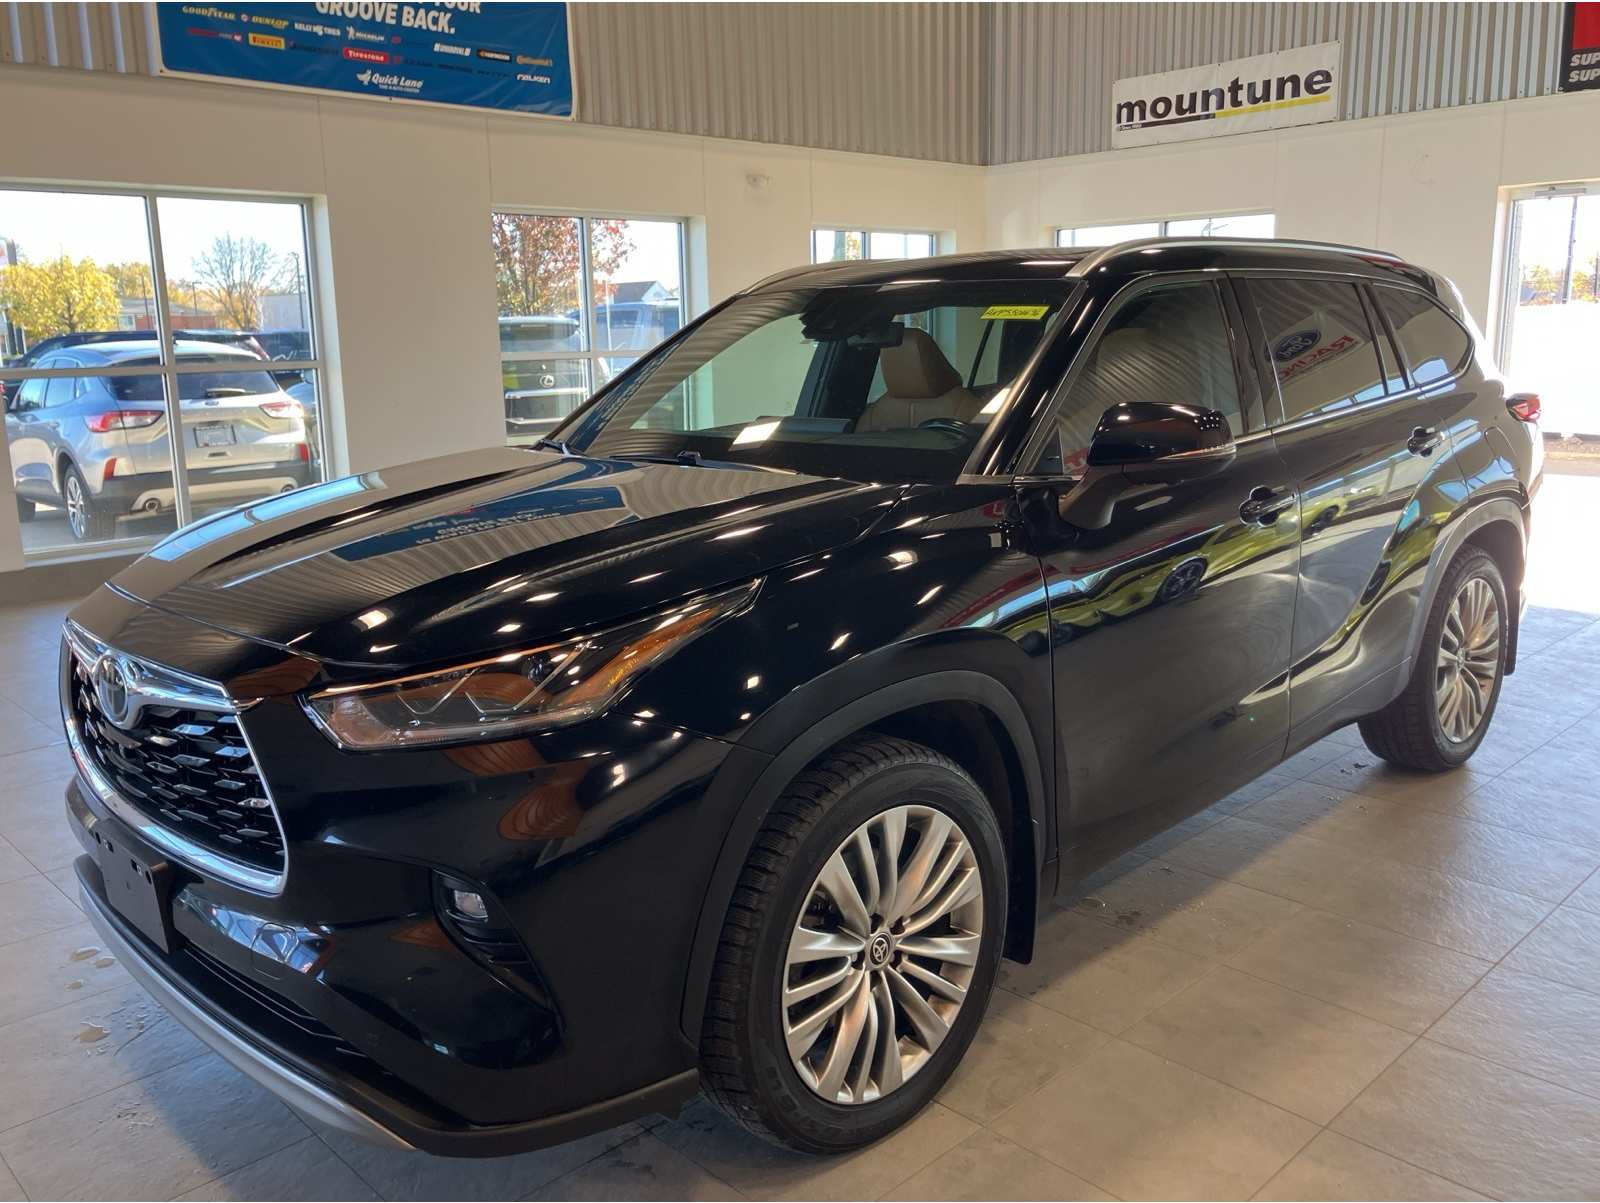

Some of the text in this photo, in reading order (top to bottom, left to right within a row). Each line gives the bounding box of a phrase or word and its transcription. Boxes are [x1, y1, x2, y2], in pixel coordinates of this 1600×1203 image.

[182, 5, 236, 20] GOODYEAR
[251, 15, 289, 27] DUNLOP
[315, 2, 456, 35] GROOVE BACK.
[371, 72, 399, 86] Quick
[400, 76, 424, 89] Lane
[1116, 69, 1332, 125] mountune
